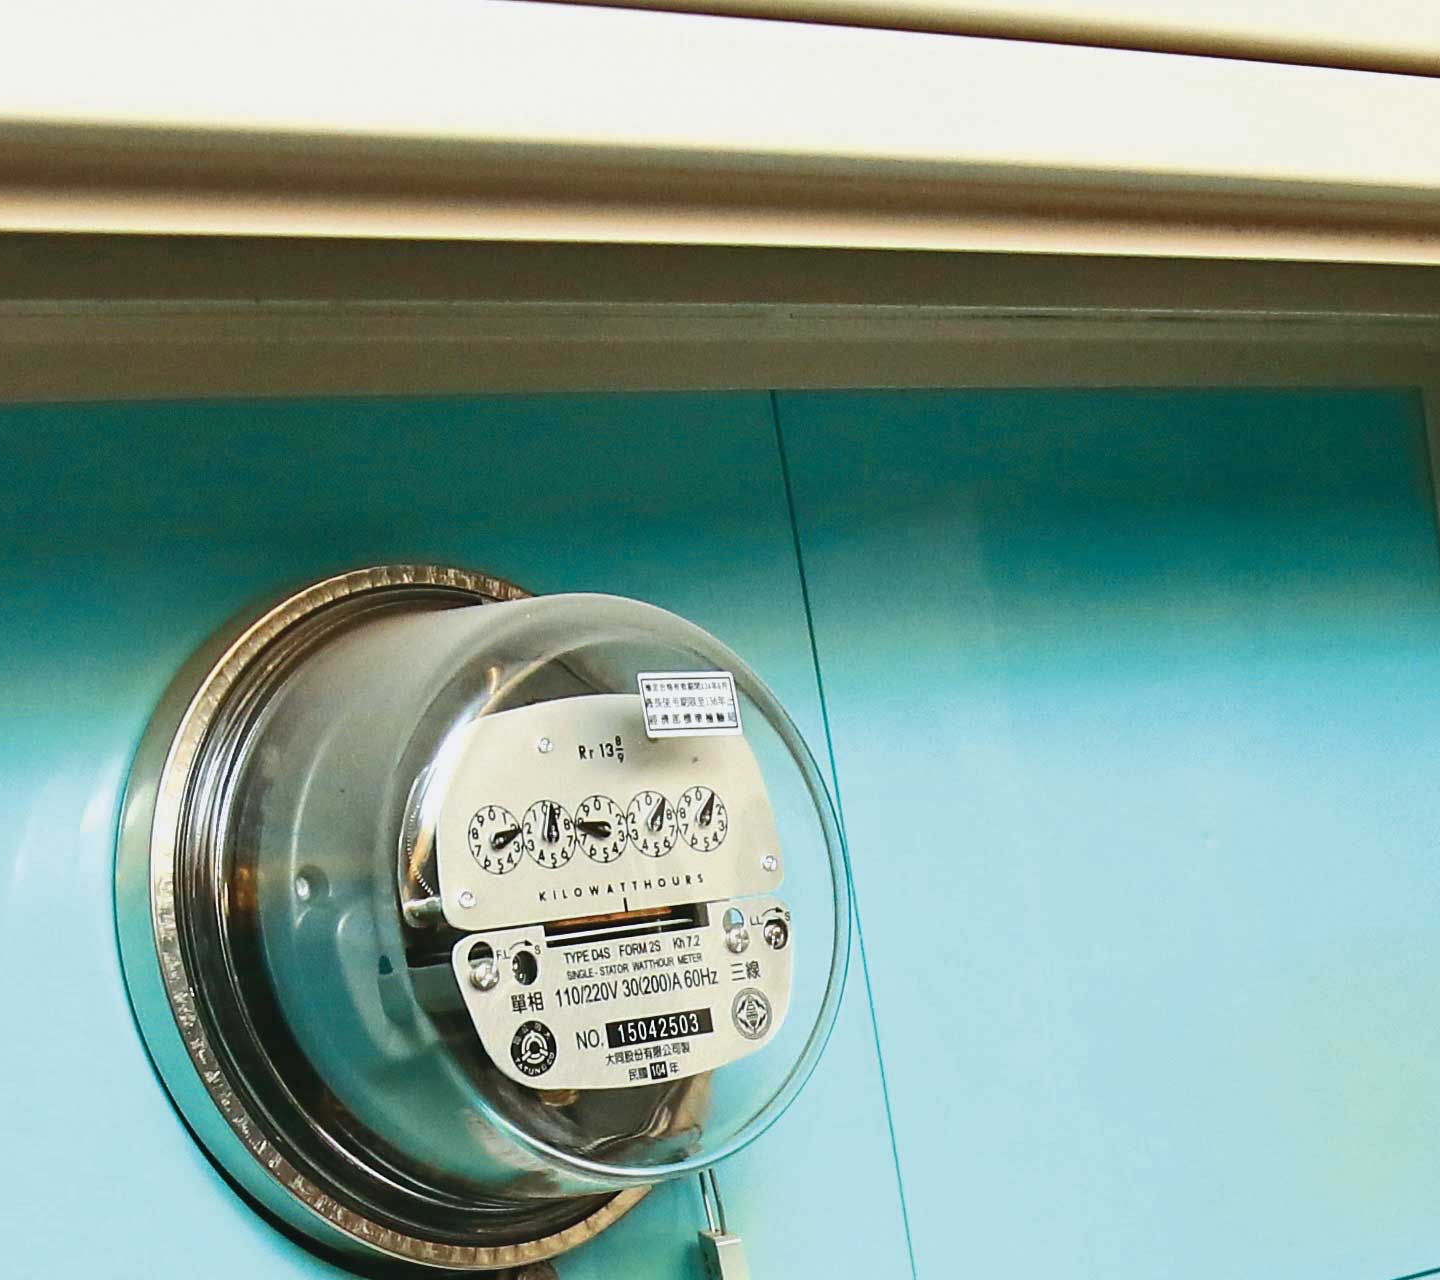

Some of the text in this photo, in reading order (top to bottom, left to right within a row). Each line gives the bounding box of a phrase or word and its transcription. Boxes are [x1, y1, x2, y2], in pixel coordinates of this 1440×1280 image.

[578, 743, 614, 761] Rr 13
[538, 872, 705, 903] KILOWATTHOURS
[564, 934, 701, 965] TYPE D4S FORM 2S Kh 7.2
[632, 951, 703, 972] WATTHOUR METER
[730, 958, 761, 983] 三線
[555, 967, 719, 1009] 110/220V 30(200)A 60Hz
[510, 990, 544, 1014] 單相
[575, 1013, 700, 1051] NO. 15042503
[605, 1041, 691, 1066] 大同股份有限公司製
[628, 1061, 680, 1082] 民國 104 年
